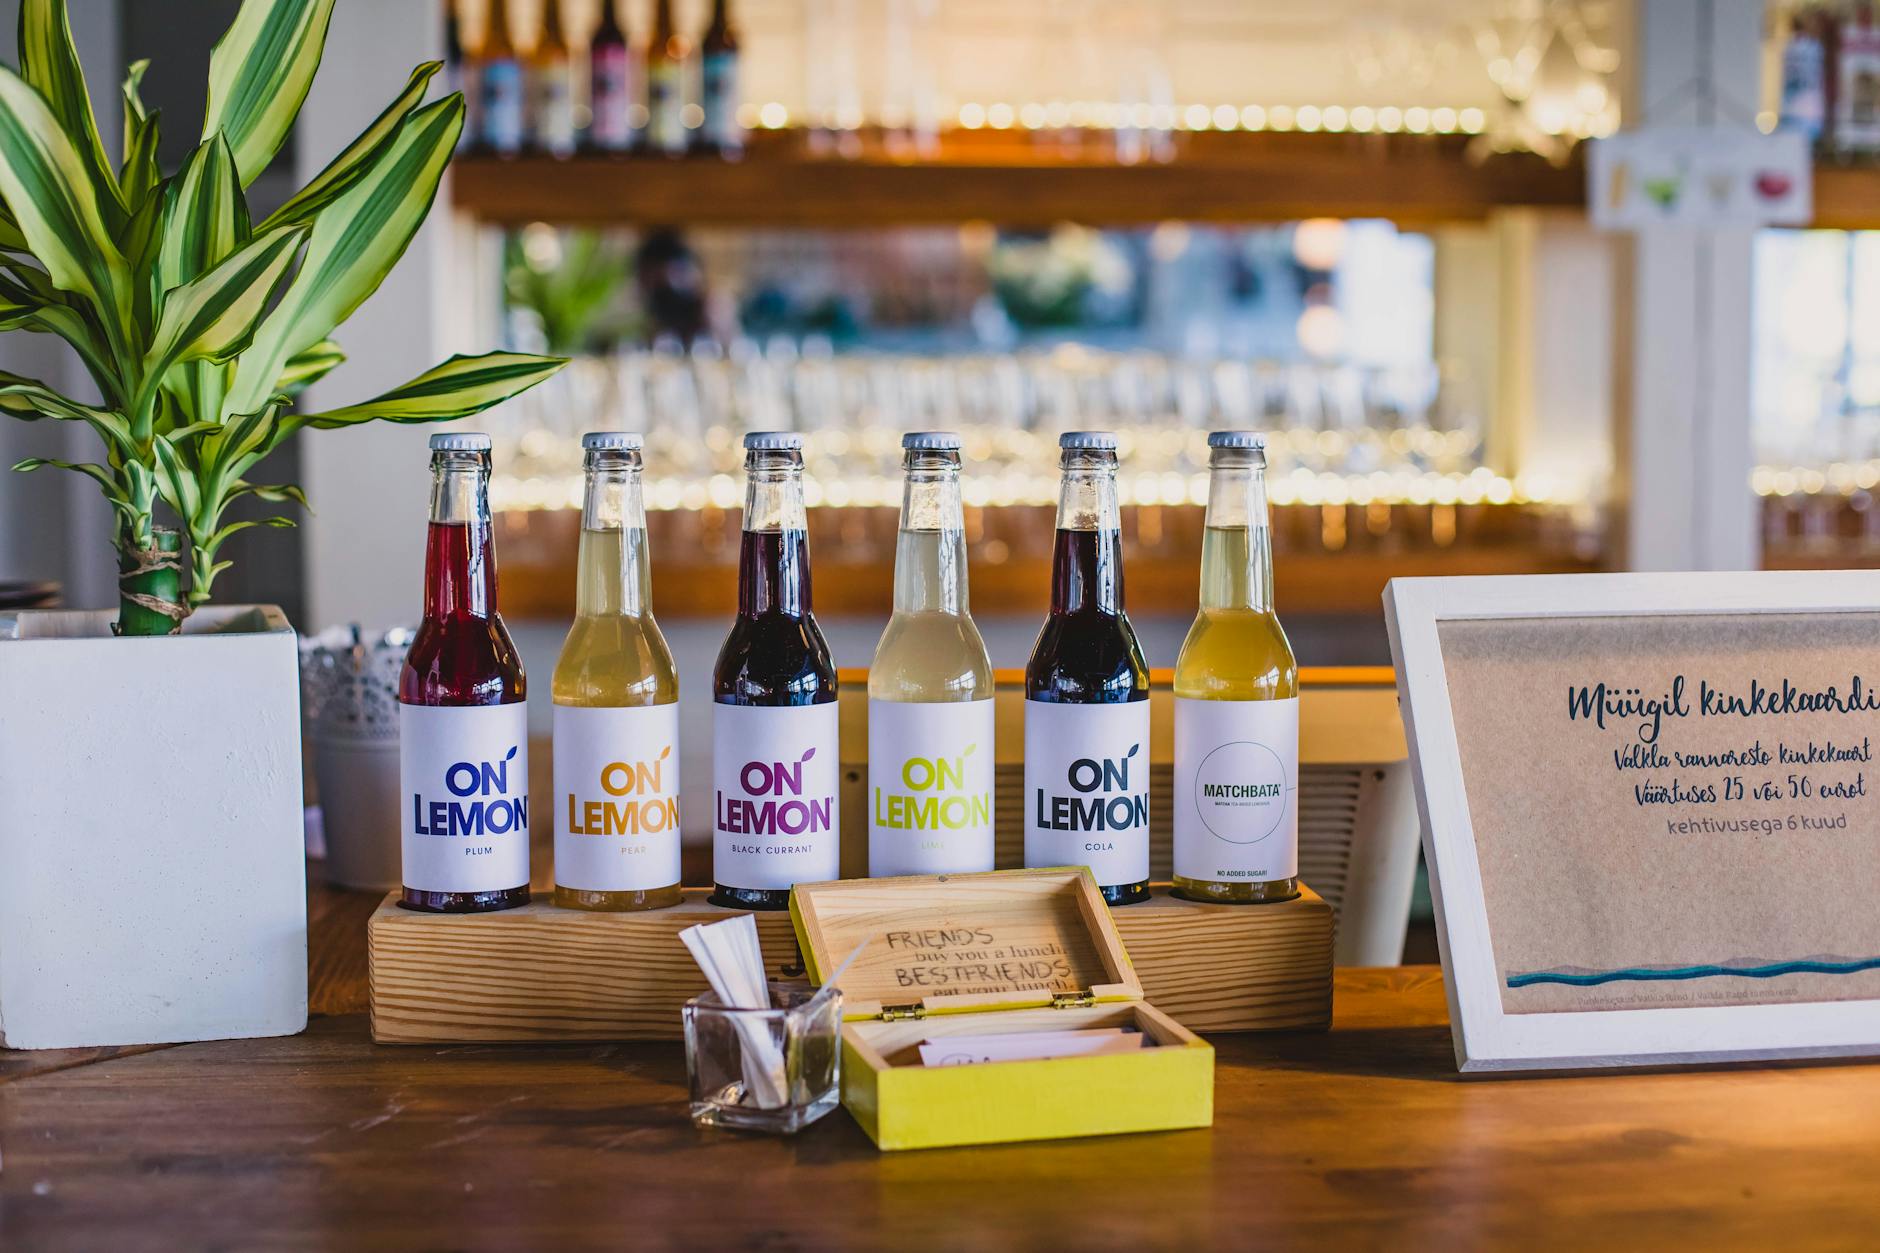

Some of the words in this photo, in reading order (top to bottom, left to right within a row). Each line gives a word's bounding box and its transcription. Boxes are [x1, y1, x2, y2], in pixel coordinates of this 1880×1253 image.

[1568, 675, 1690, 743] Müügil
[1700, 675, 1880, 717] kinkekaardi
[1614, 743, 1671, 770] Valkla
[1674, 740, 1772, 768] rannaresto
[1779, 737, 1872, 765] kinkekaart
[445, 760, 506, 797] ON
[600, 760, 661, 796] ON
[740, 761, 802, 796] ON
[902, 757, 964, 791] ON
[1068, 758, 1128, 793] ON
[1634, 778, 1717, 806] Väärtuses
[1723, 776, 1744, 801] 25
[1753, 780, 1783, 800] või
[1787, 774, 1812, 798] 50
[1820, 772, 1866, 799] eurot
[414, 793, 527, 837] LEMON
[568, 793, 679, 836] LEMON
[875, 787, 989, 830] LEMON
[1037, 788, 1148, 831] LEMON
[1667, 815, 1782, 836] kehtivusega
[1787, 815, 1797, 830] 6
[1802, 813, 1847, 831] kuud
[465, 847, 493, 856] PLUM
[621, 847, 646, 855] PEAR
[732, 844, 761, 854] BLACK
[766, 844, 812, 855] CURRANT
[1085, 843, 1113, 851] COLA
[887, 928, 994, 949] FRIENDS
[995, 949, 1004, 958] a
[896, 959, 1071, 986] BESTFRIENDS
